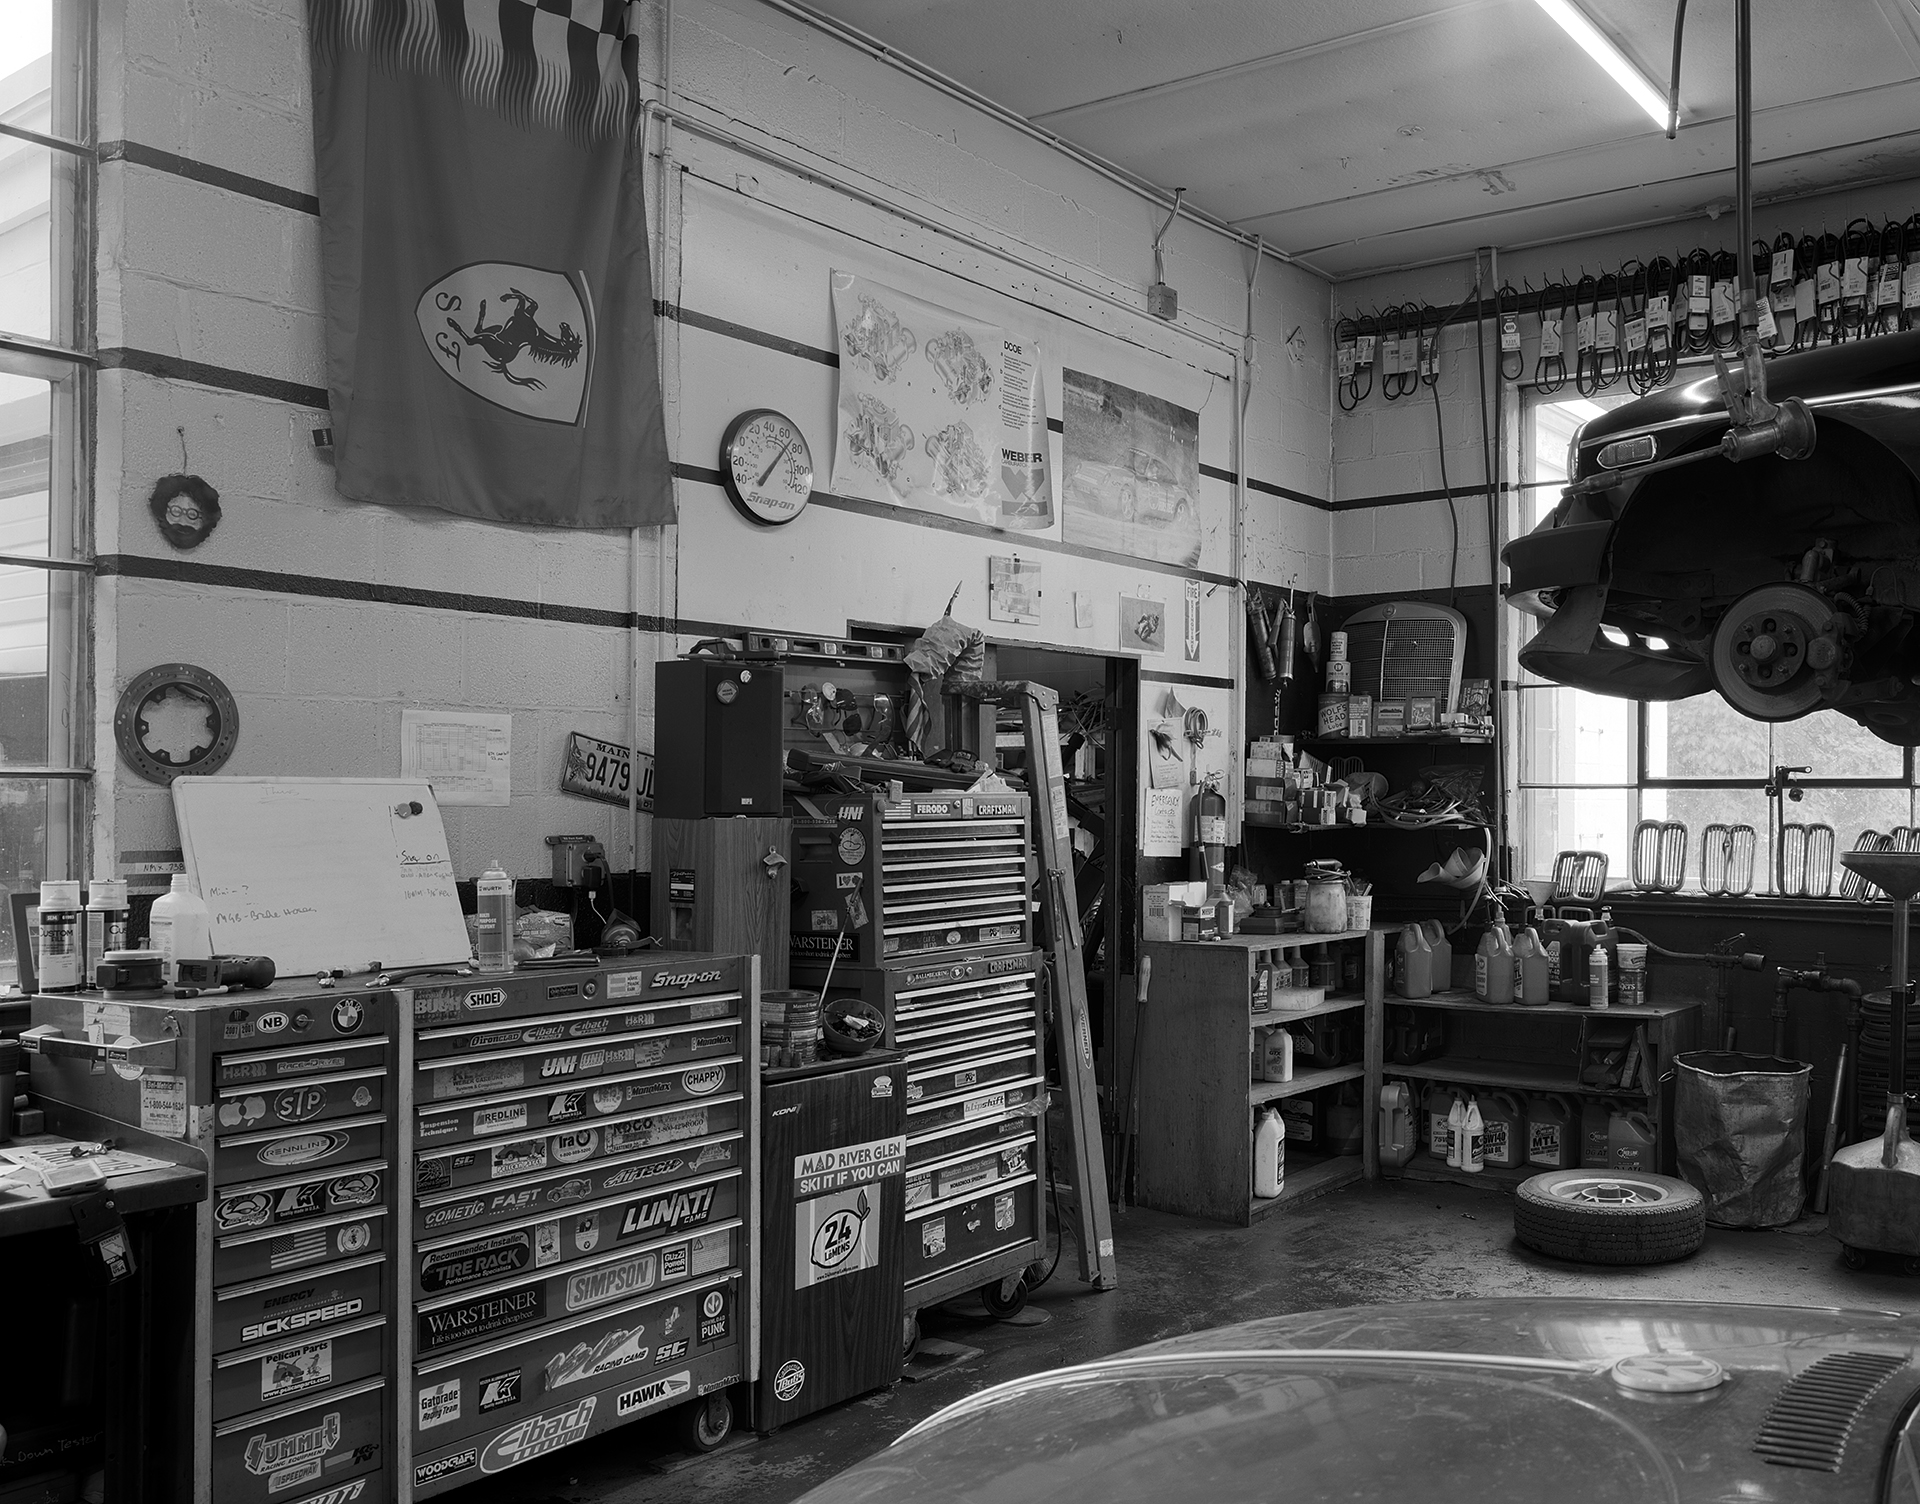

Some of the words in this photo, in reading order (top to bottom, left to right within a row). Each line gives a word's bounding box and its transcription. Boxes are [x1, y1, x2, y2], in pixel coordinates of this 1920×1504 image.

[1003, 340, 1022, 355] DCOE
[749, 424, 760, 435] 20
[763, 421, 775, 433] 40
[779, 427, 791, 439] 60
[739, 436, 746, 447] 0
[791, 443, 803, 455] 80
[733, 455, 744, 467] 20
[1001, 447, 1043, 464] WEBER
[796, 464, 810, 476] 100
[735, 473, 747, 485] 40
[795, 483, 808, 496] 120
[746, 491, 796, 511] Snap-on
[1321, 703, 1347, 718] WOLF'S
[1323, 713, 1347, 725] HEAD
[1327, 722, 1343, 730] Lube
[585, 752, 630, 791] 9479
[916, 804, 949, 815] FERODO
[978, 804, 1017, 816] CRAFTSMAN
[989, 958, 1028, 973] CRAFTSMAN
[650, 970, 722, 990] Snap-on
[336, 999, 363, 1013] BMW
[470, 992, 501, 1006] SHOEI
[225, 1026, 238, 1035] 2001
[263, 1017, 283, 1029] NB
[570, 1019, 610, 1036] Eibach
[522, 1025, 565, 1042] Eibach
[223, 1066, 251, 1080] H&R
[541, 1056, 578, 1078] UNI
[687, 1070, 721, 1084] CHAPPY
[281, 1087, 321, 1118] STP
[485, 1108, 526, 1121] REDLINE
[772, 1106, 797, 1118] KONI
[420, 1118, 459, 1129] Suspension
[420, 1126, 458, 1138] Techniques
[266, 1139, 328, 1157] RENNLINE
[559, 1134, 575, 1149] Ira
[1532, 1136, 1558, 1148] MTL
[801, 1153, 836, 1176] MAD
[839, 1148, 872, 1168] RIVER
[873, 1142, 901, 1160] GLEN
[800, 1176, 821, 1194] SKI
[823, 1173, 835, 1189] IT
[836, 1171, 848, 1186] IF
[851, 1165, 875, 1182] YOU
[877, 1160, 900, 1176] CAN
[491, 1188, 542, 1210] FAST
[425, 1201, 486, 1225] COMETIC
[622, 1186, 716, 1234] LUNATI
[684, 1211, 708, 1224] CAMS
[825, 1214, 852, 1250] 24
[429, 1242, 489, 1263] Recommended
[490, 1233, 524, 1248] Installer
[436, 1259, 473, 1281] TIRE
[475, 1248, 521, 1275] RACK
[445, 1271, 482, 1286] Performance
[482, 1264, 512, 1277] Specialists
[574, 1260, 649, 1303] SIMPSON
[263, 1287, 316, 1310] ENERGY
[242, 1298, 363, 1342] SICKSPEED
[263, 1306, 302, 1320] PERFORMANCE
[428, 1291, 538, 1334] WARSTEINER
[701, 1314, 726, 1327] DOWNLOAD
[431, 1332, 445, 1346] Life
[451, 1330, 462, 1340] too
[461, 1325, 479, 1337] short
[479, 1324, 487, 1333] to
[486, 1317, 502, 1330] drink
[502, 1314, 520, 1327] cheap
[701, 1322, 726, 1339] PUNK
[266, 1348, 301, 1365] Pelican
[303, 1341, 328, 1355] Parts
[593, 1357, 623, 1374] RACING
[623, 1350, 647, 1365] CAMS
[263, 1375, 331, 1399] www.pelicanparts.com
[619, 1380, 667, 1411] HAWK
[421, 1388, 458, 1410] Gatorade
[421, 1407, 442, 1422] Racing
[442, 1403, 458, 1415] Team
[481, 1397, 596, 1473] Eibach
[260, 1459, 286, 1472] RACING
[288, 1448, 326, 1465] EQUIPMENT
[416, 1450, 476, 1479] WOODCRAFT
[281, 1463, 319, 1484] SPEEDWAY
